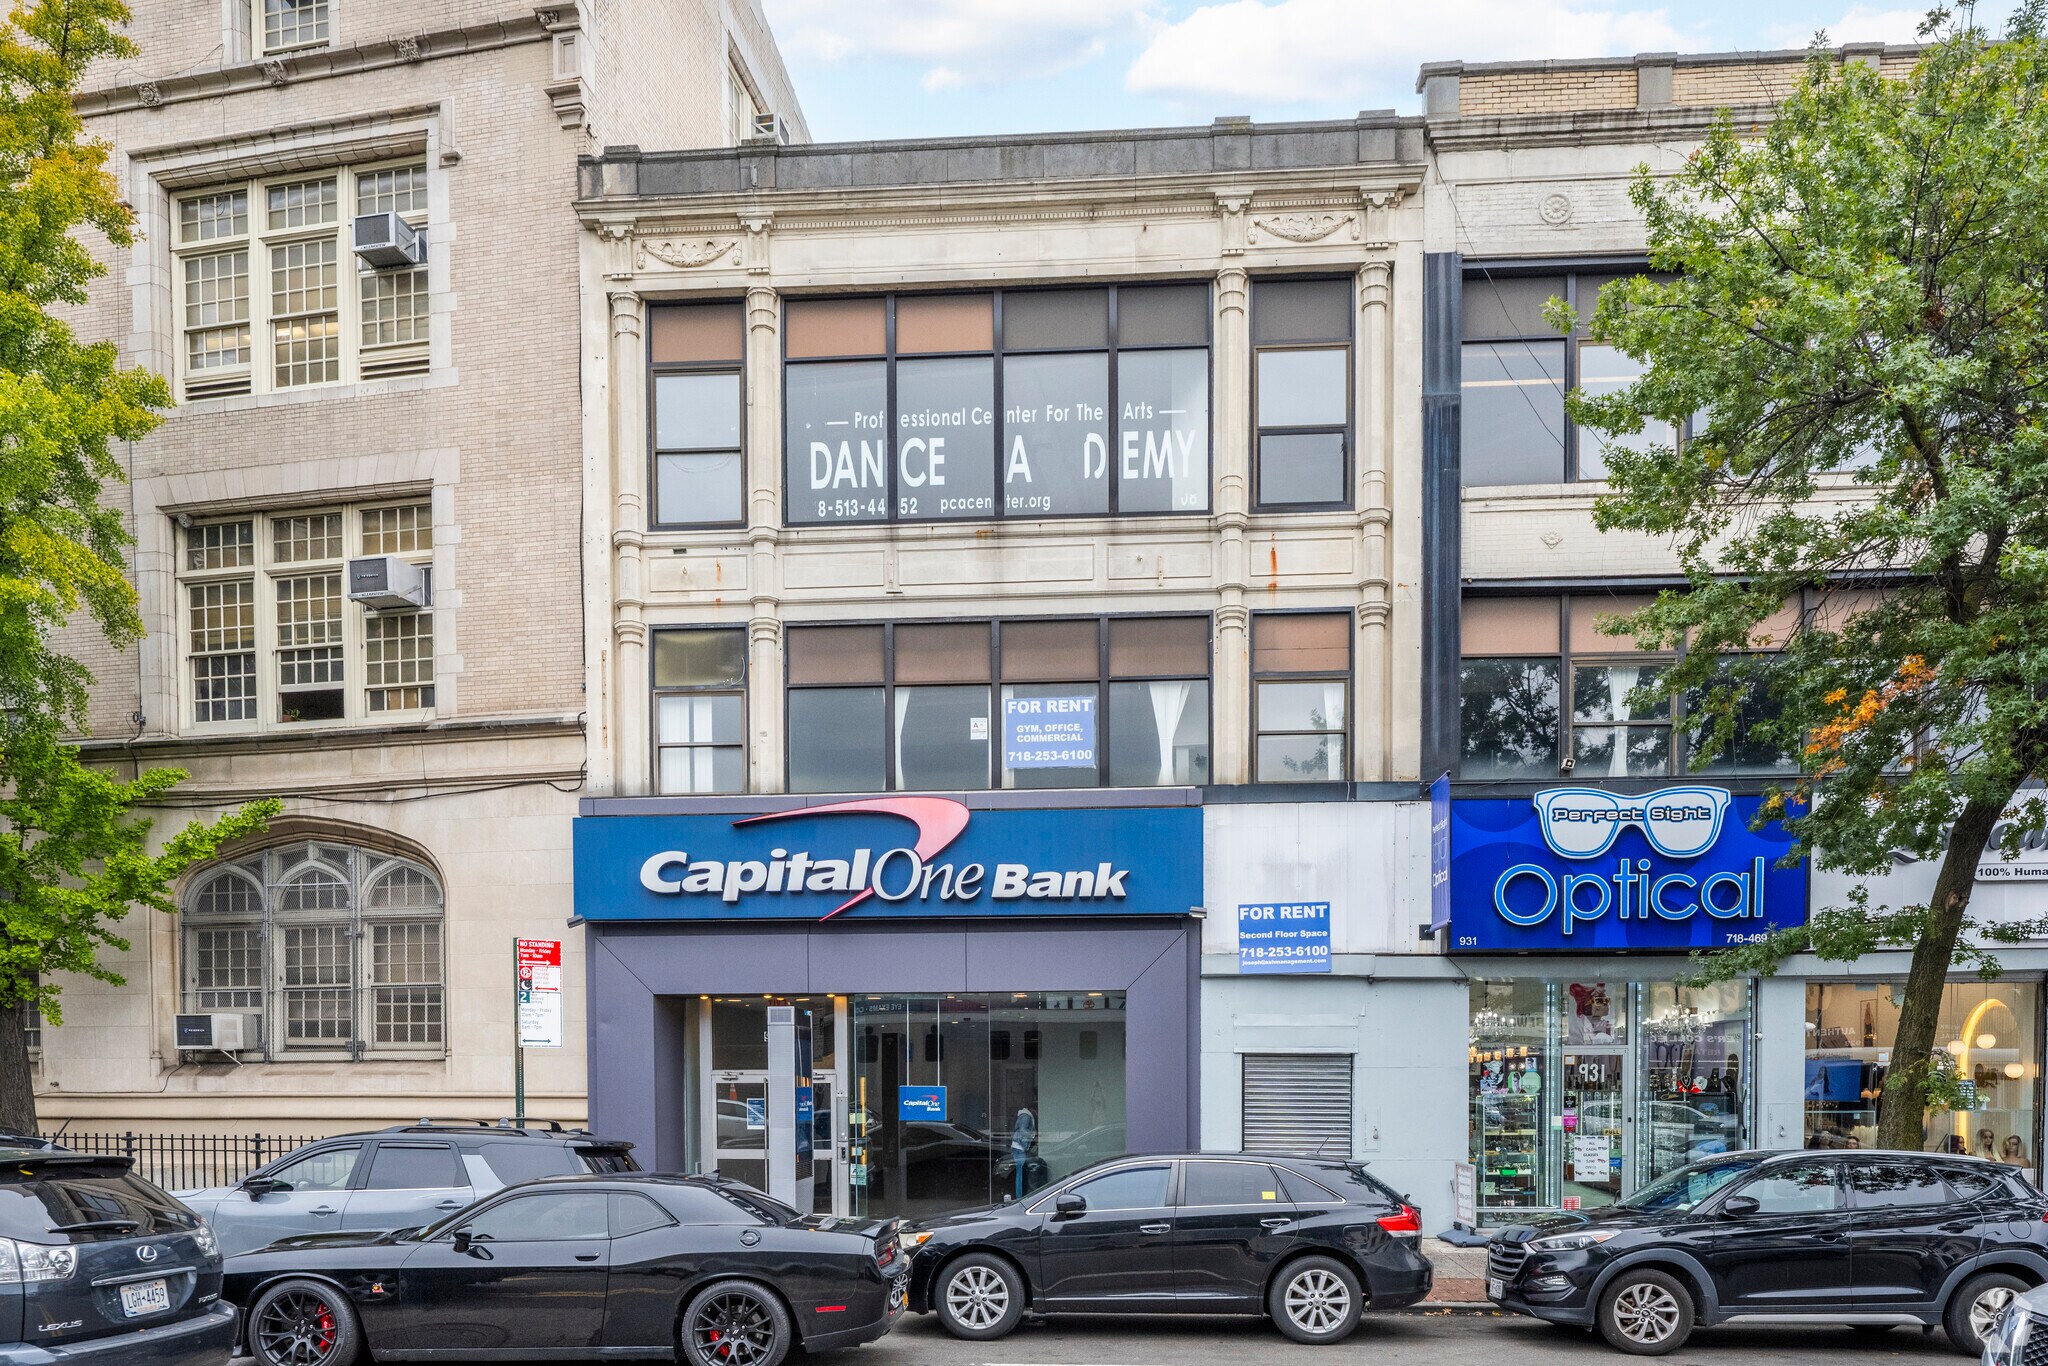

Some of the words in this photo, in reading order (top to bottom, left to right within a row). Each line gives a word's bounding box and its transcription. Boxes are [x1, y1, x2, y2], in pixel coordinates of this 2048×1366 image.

[1046, 404, 1070, 421] For
[1076, 403, 1102, 420] The
[1123, 402, 1152, 419] Arts
[1007, 700, 1042, 713] FOR
[1046, 699, 1092, 712] RENT
[1016, 724, 1042, 732] GYM,
[1044, 723, 1084, 731] OFFICE,
[1016, 733, 1084, 742] COMMERCIAL
[1007, 750, 1092, 761] 718-253-6100
[1552, 808, 1644, 823] Perfect
[1650, 806, 1710, 821] Sight
[1432, 866, 1448, 888] Optical
[1977, 867, 2010, 876] 100%
[991, 862, 1130, 899] Bank
[1494, 855, 1766, 935] Optical
[1239, 906, 1274, 920] FOR
[1280, 904, 1328, 918] RENT
[1239, 930, 1272, 939] Second
[1300, 929, 1328, 938] Space
[1725, 933, 1768, 943] 718-469
[1459, 936, 1478, 945] 931
[1240, 945, 1328, 957] 718-253-6100
[519, 991, 526, 1002] 2
[1578, 1063, 1606, 1082] 931
[38, 1319, 82, 1331] LEXUS
